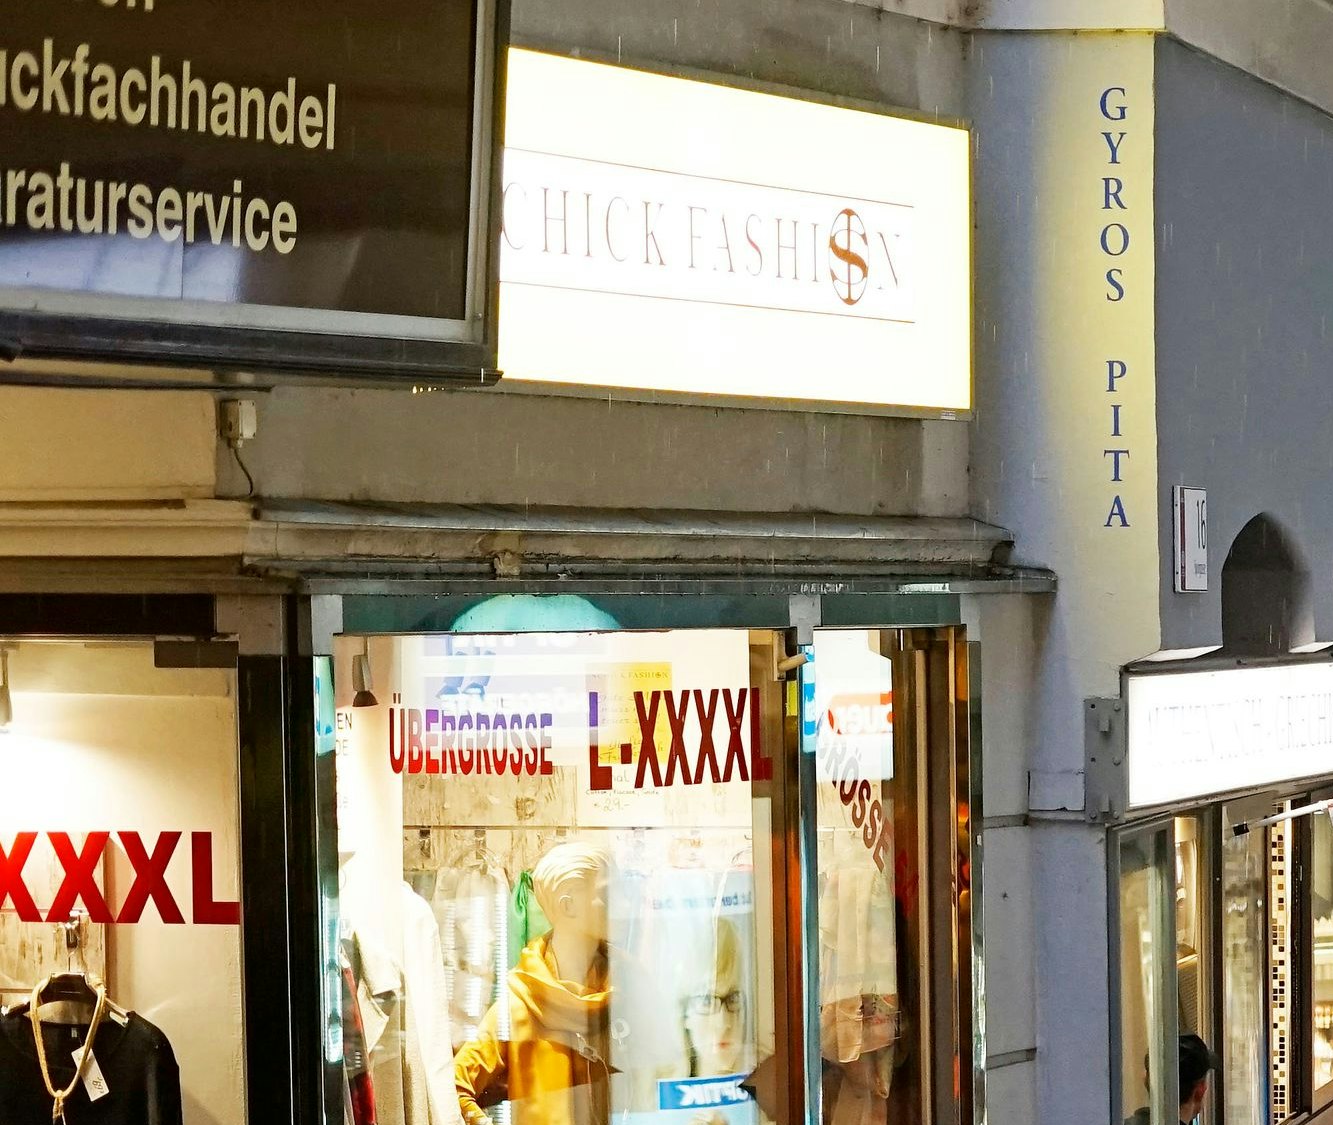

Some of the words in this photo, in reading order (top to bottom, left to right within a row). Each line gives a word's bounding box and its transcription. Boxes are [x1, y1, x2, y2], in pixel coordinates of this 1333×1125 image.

[0, 38, 336, 150] ckfachhandel
[0, 162, 298, 255] raturservice
[1099, 86, 1130, 303] GYROS
[1103, 359, 1131, 529] PITA
[1196, 499, 1206, 550] 16
[588, 687, 774, 791] L-XXXXL
